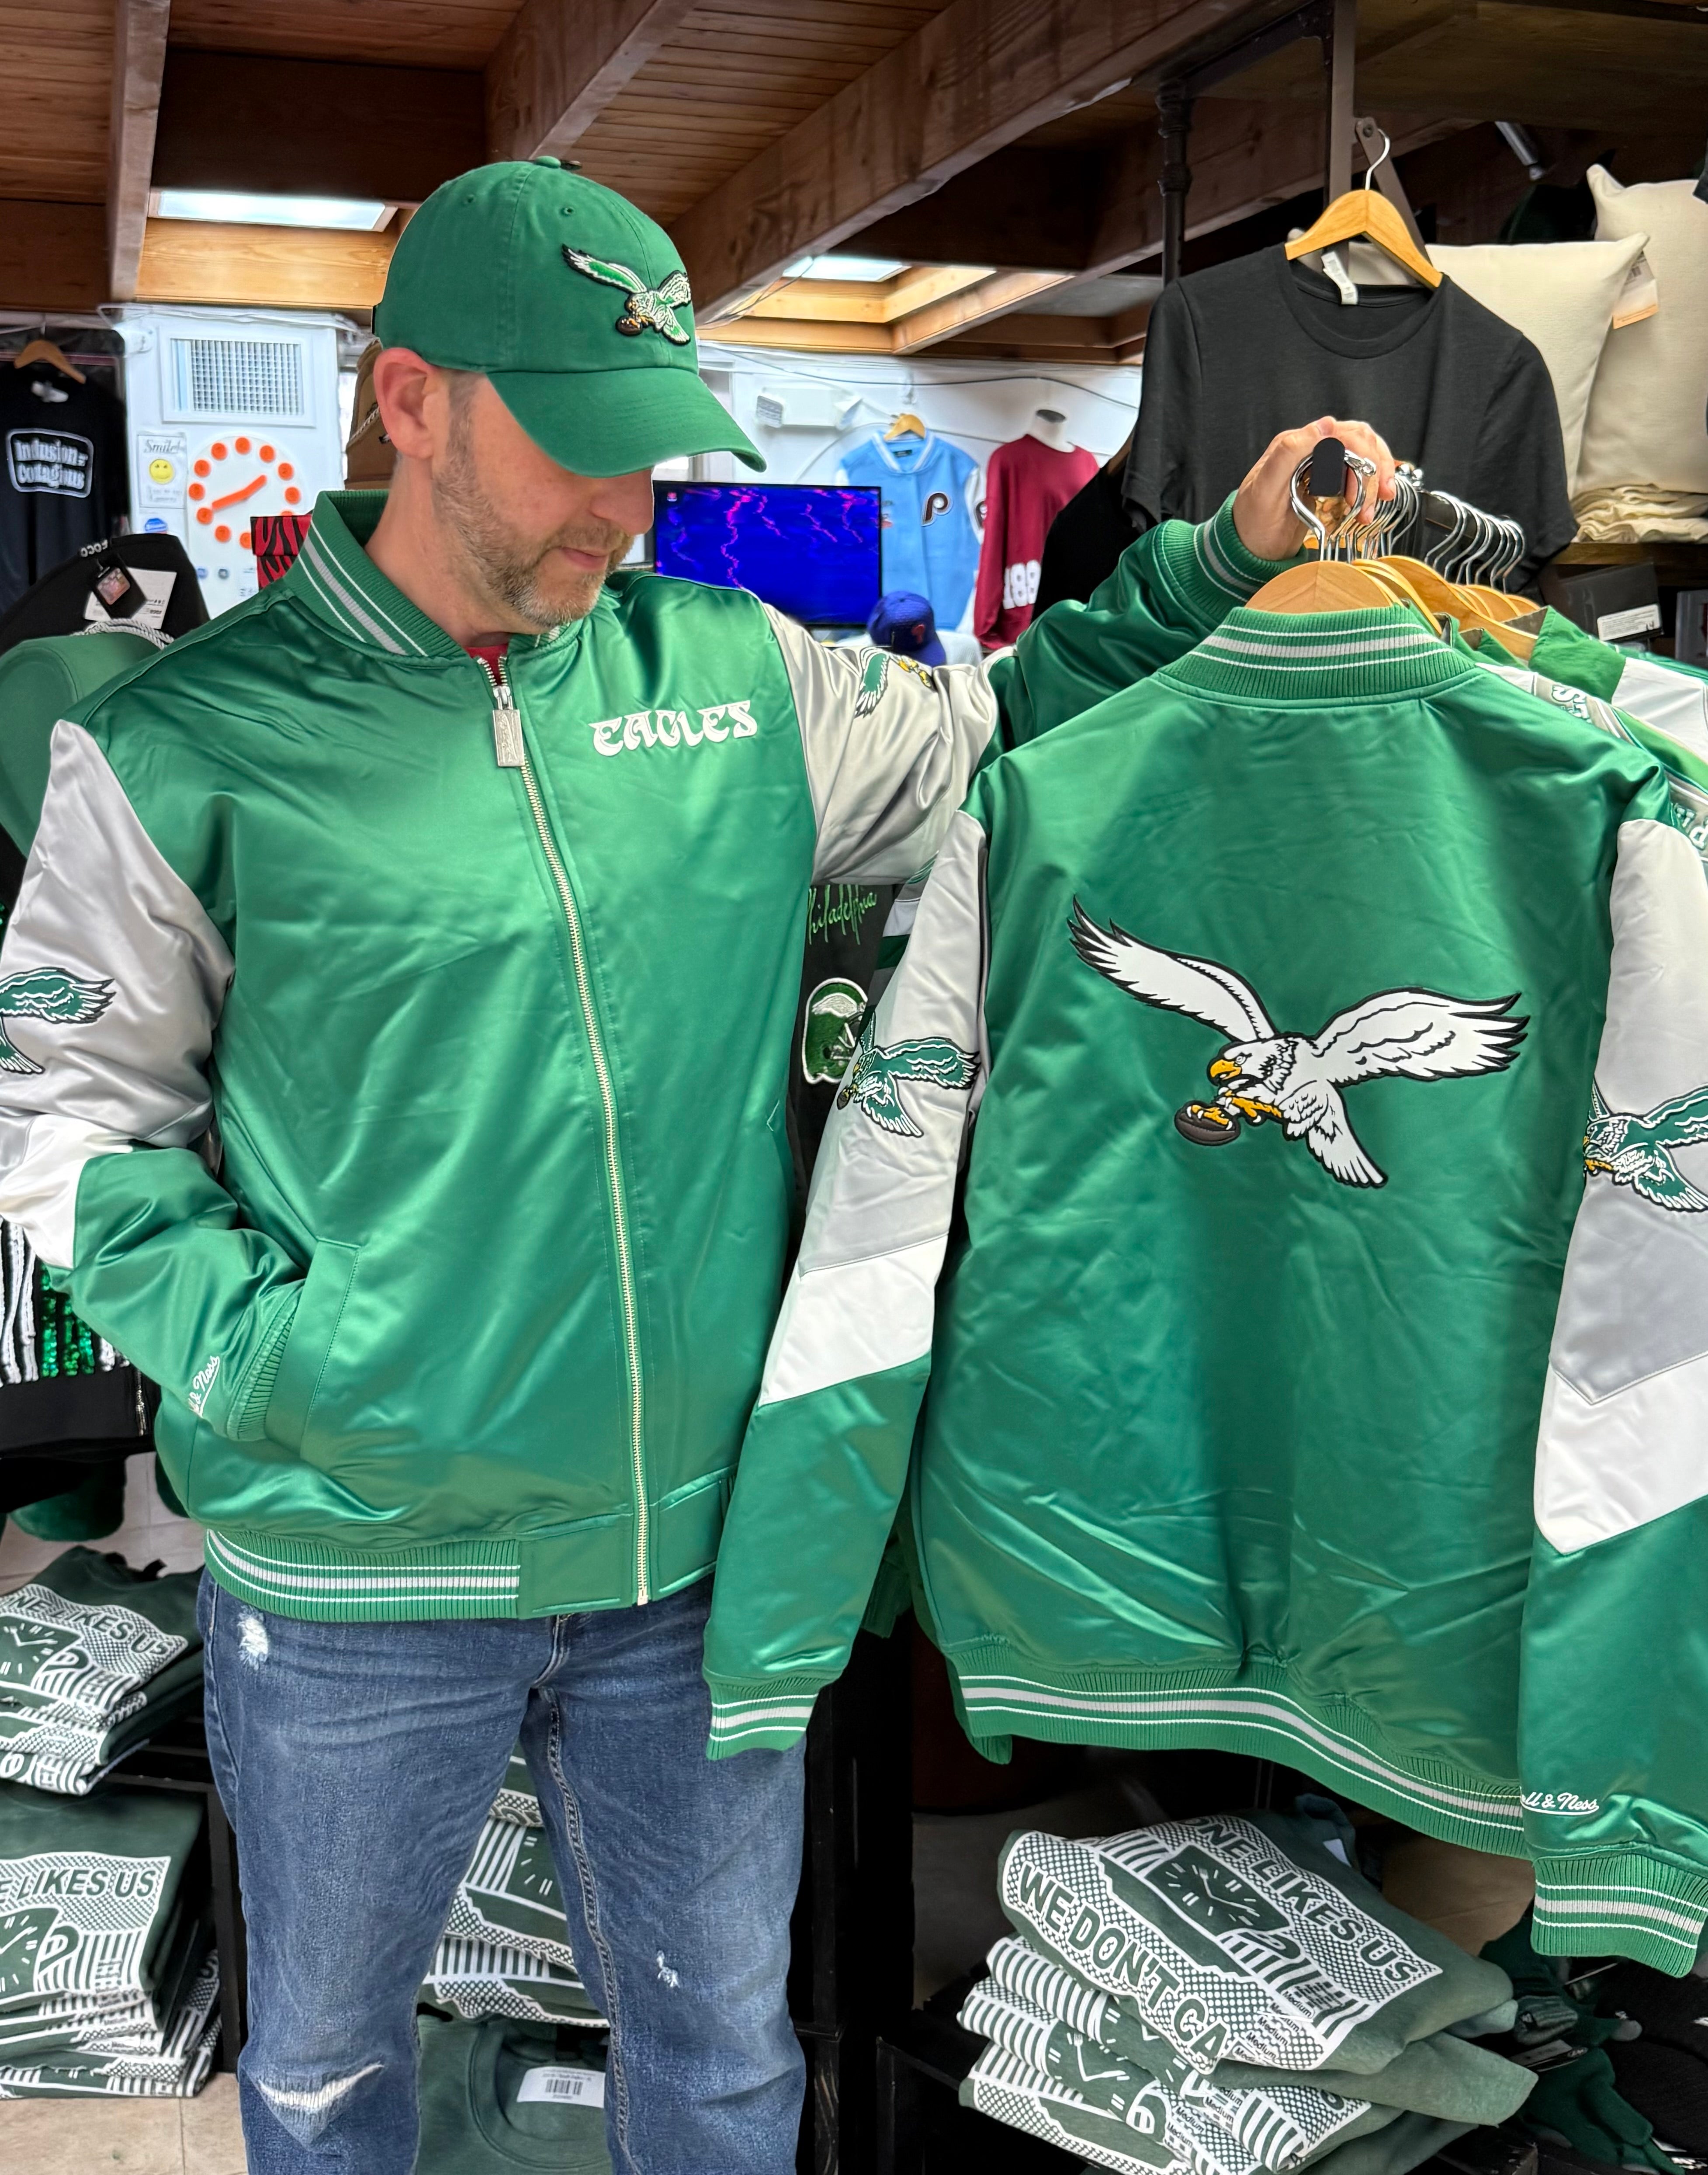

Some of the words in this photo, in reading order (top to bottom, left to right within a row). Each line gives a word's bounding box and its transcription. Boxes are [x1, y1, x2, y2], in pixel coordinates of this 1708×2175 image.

[923, 492, 952, 526] P
[589, 700, 757, 756] EAGLES
[1542, 1794, 1556, 1808] &
[1557, 1792, 1599, 1810] Ness
[17, 1869, 109, 1900] LIKES
[115, 1870, 156, 1898] US
[1251, 1860, 1363, 1941] LIKES
[1360, 1939, 1418, 1981] US
[1021, 1863, 1076, 1931] WE
[1067, 1903, 1181, 2010] DON'T
[1283, 1991, 1312, 2017] Medium
[1258, 2017, 1288, 2046] Medium
[1246, 2032, 1277, 2060] Medium
[1177, 2107, 1204, 2133] Medium
[1206, 2096, 1233, 2123] Medium
[1168, 2122, 1193, 2147] Medium
